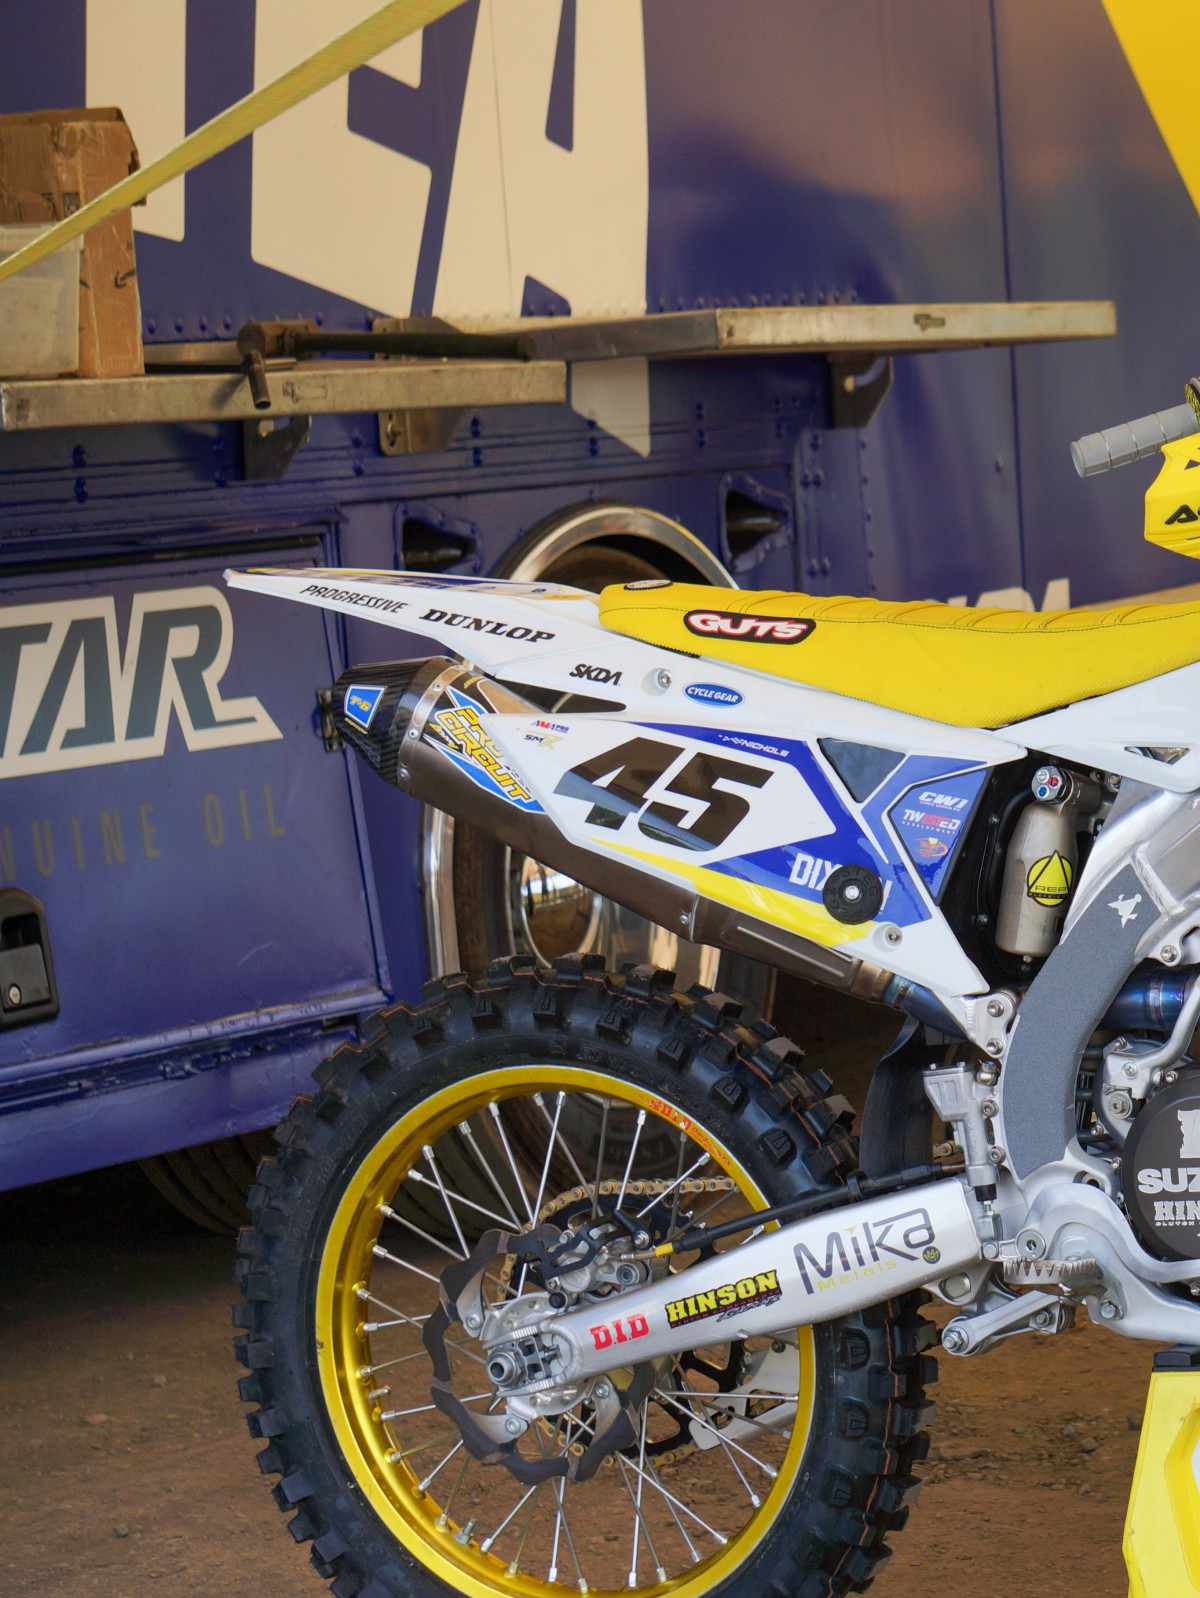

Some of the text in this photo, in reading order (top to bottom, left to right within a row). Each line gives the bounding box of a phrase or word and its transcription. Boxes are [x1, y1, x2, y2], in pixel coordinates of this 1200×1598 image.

[300, 585, 408, 614] PROGRESSIVE
[418, 608, 556, 643] DUNLOP
[687, 612, 811, 640] GUTS
[569, 663, 622, 686] SKDA
[687, 687, 739, 703] CYCLE GEAR
[437, 713, 531, 801] CIRCUIT
[741, 741, 790, 758] NICHOLS
[553, 736, 775, 852] 45
[203, 785, 286, 849] OIL
[1035, 885, 1067, 893] REP
[793, 1208, 936, 1296] Mika
[817, 1259, 898, 1292] Metals
[666, 1271, 778, 1323] HINSON
[590, 1315, 649, 1351] D.I.D
